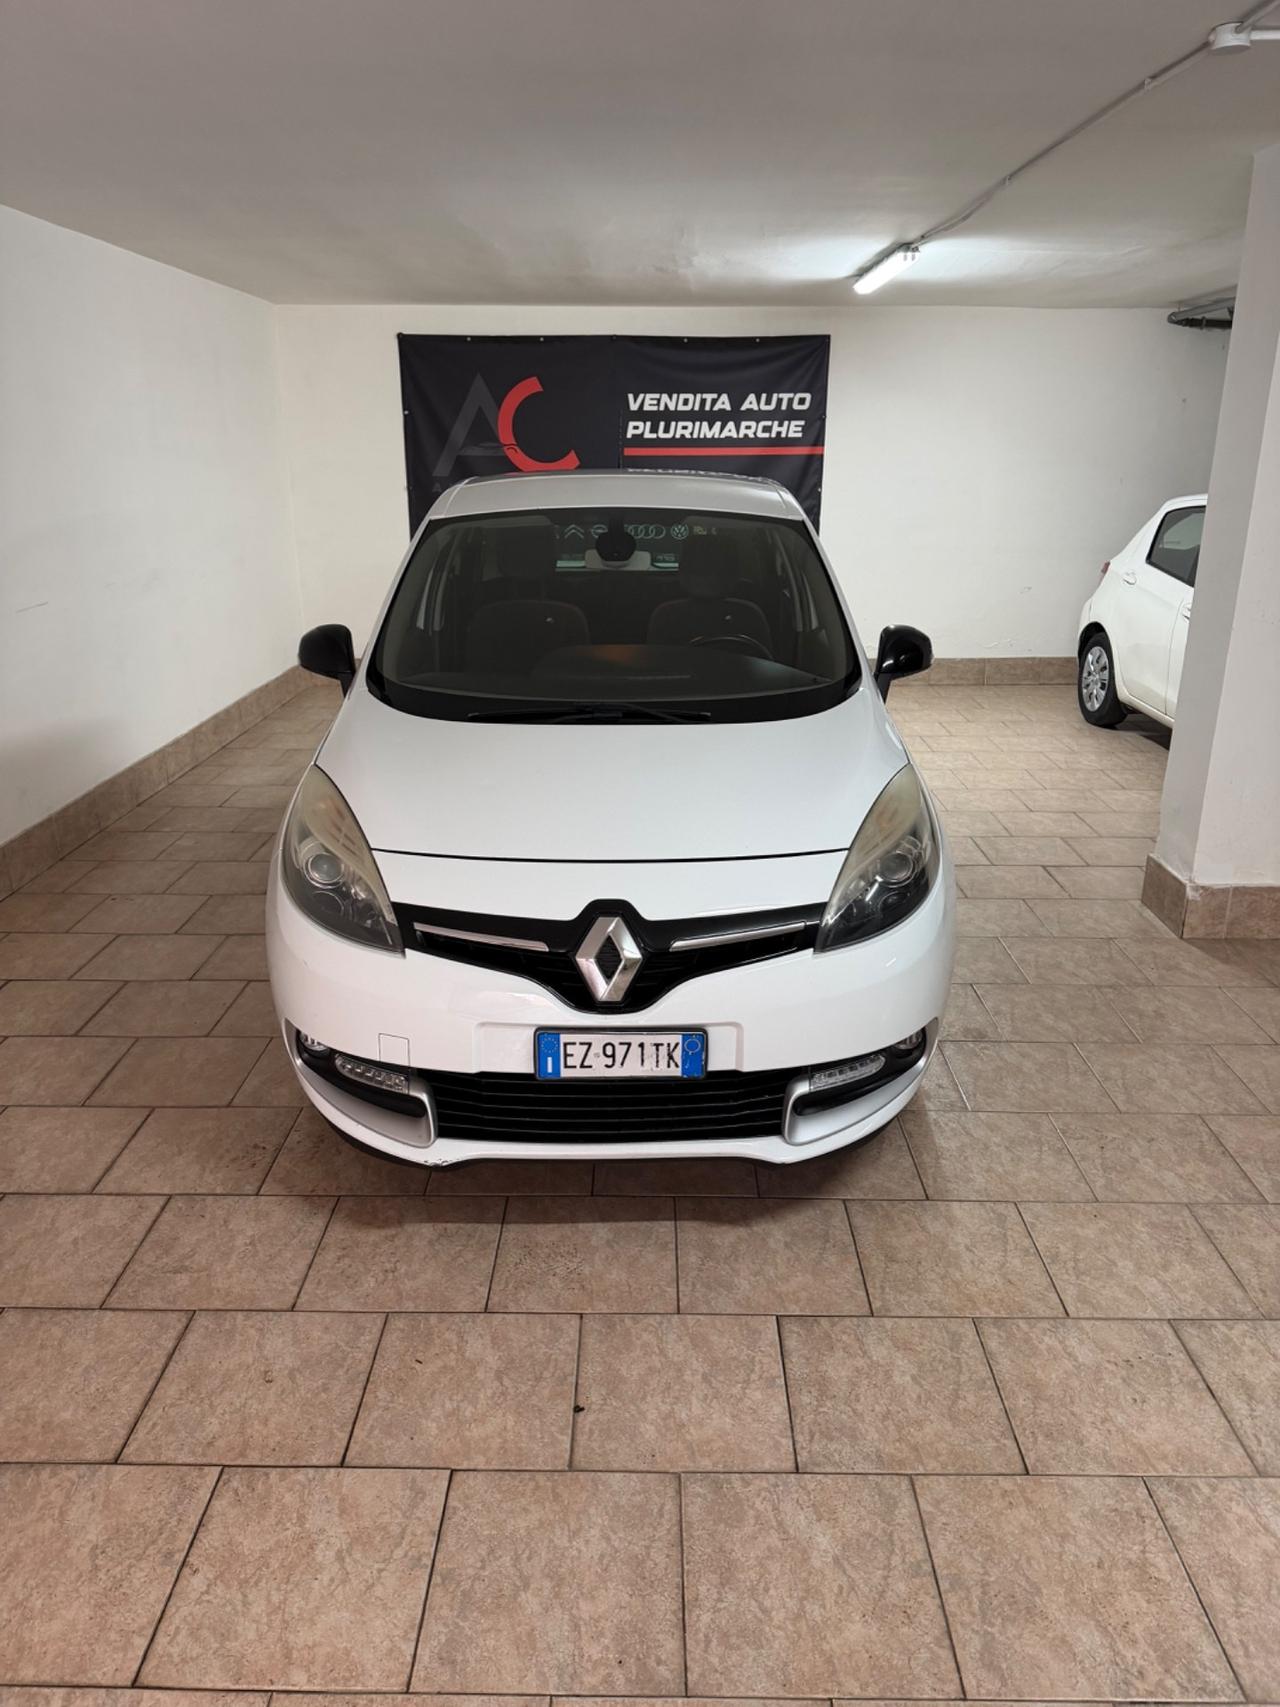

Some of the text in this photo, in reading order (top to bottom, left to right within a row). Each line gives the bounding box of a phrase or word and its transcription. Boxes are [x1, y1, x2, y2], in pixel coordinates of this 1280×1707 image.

[627, 392, 812, 412] VENDITA AUTO
[626, 420, 806, 439] PLURIMARCHE
